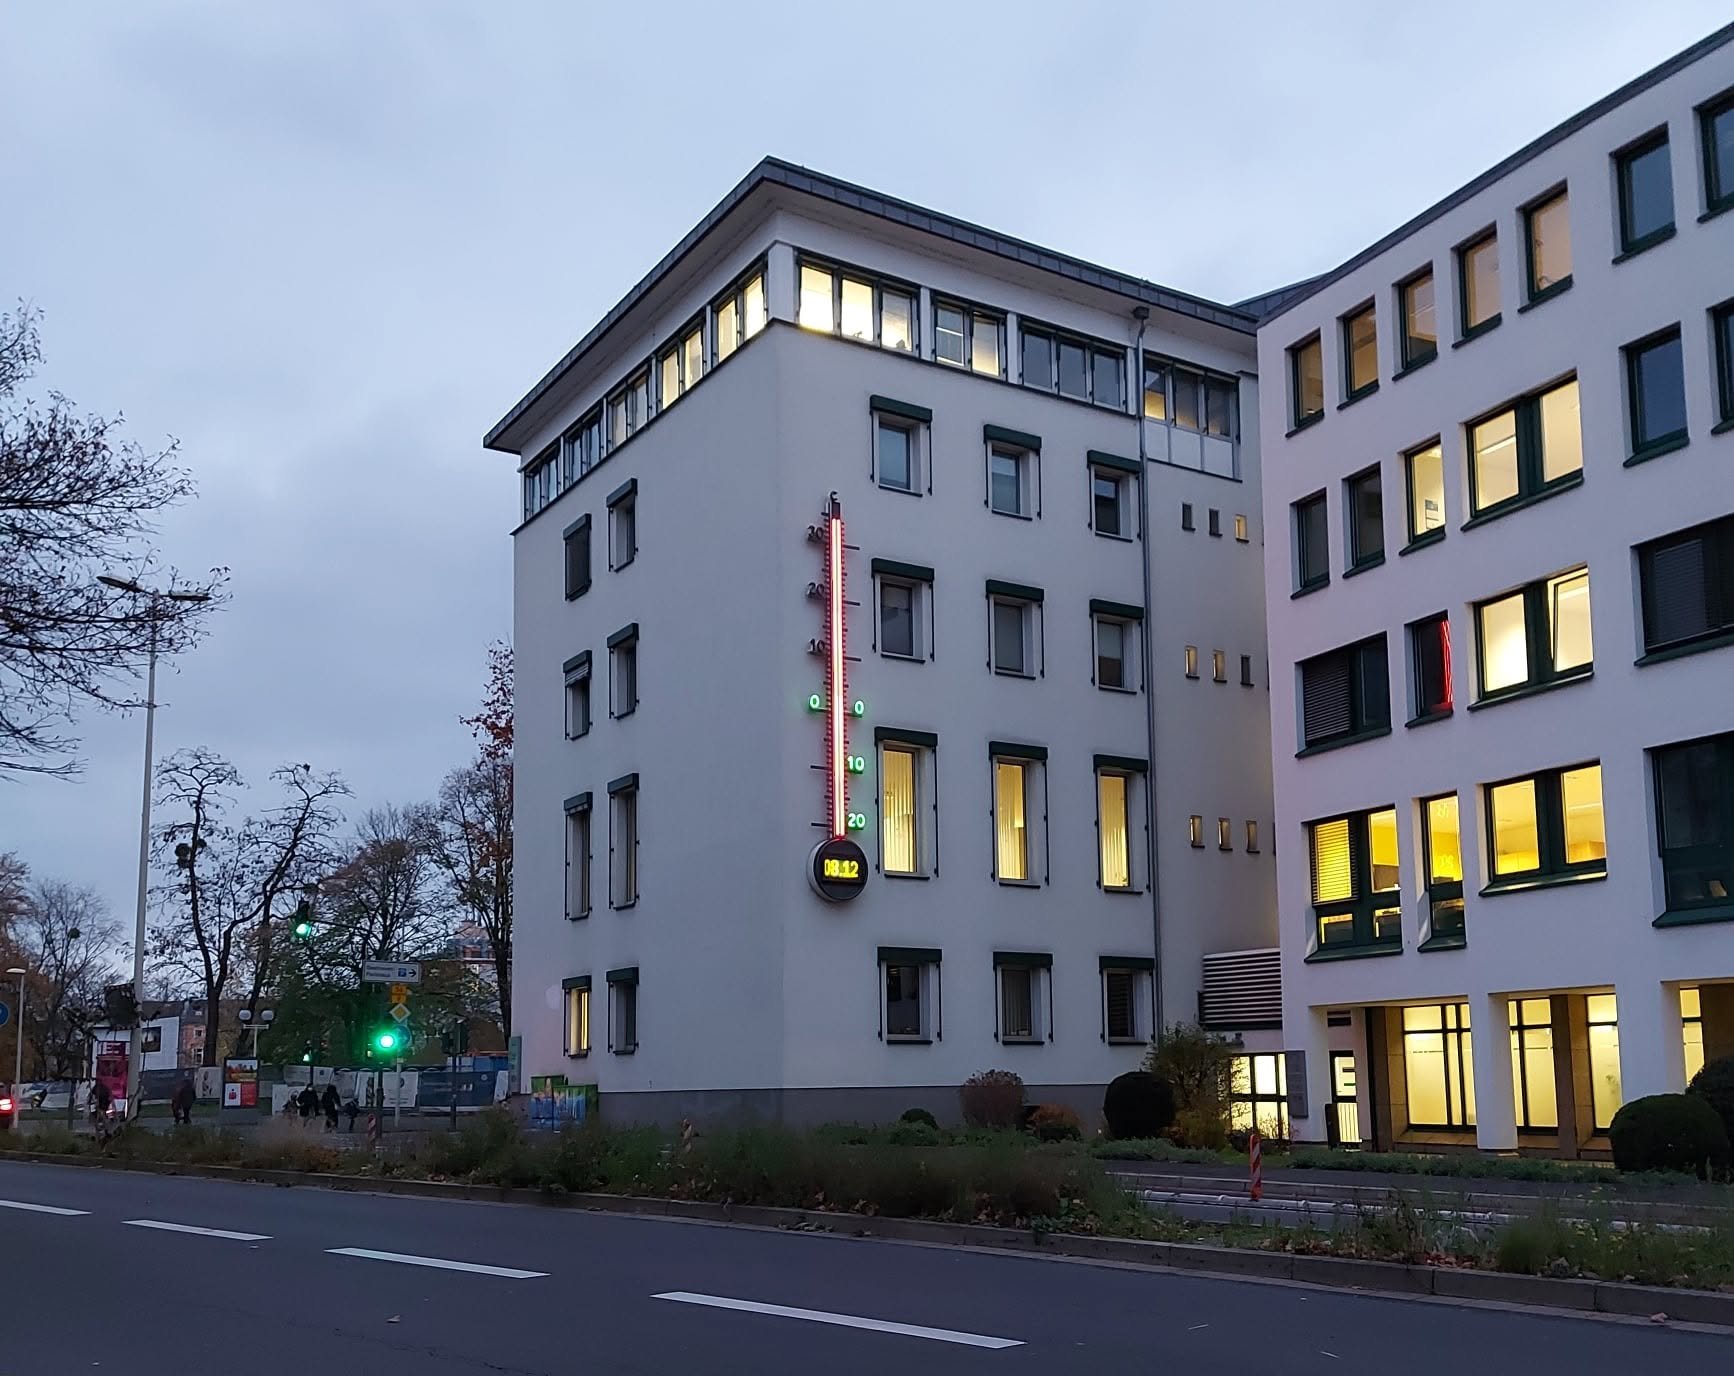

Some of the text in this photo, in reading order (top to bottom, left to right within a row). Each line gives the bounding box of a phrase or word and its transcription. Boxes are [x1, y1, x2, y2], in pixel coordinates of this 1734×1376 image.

[807, 525, 824, 541] 30
[807, 582, 825, 596] 20
[809, 638, 825, 653] 10
[809, 694, 820, 708] 0
[854, 700, 865, 715] 0
[847, 756, 865, 771] 10
[848, 813, 866, 828] 20
